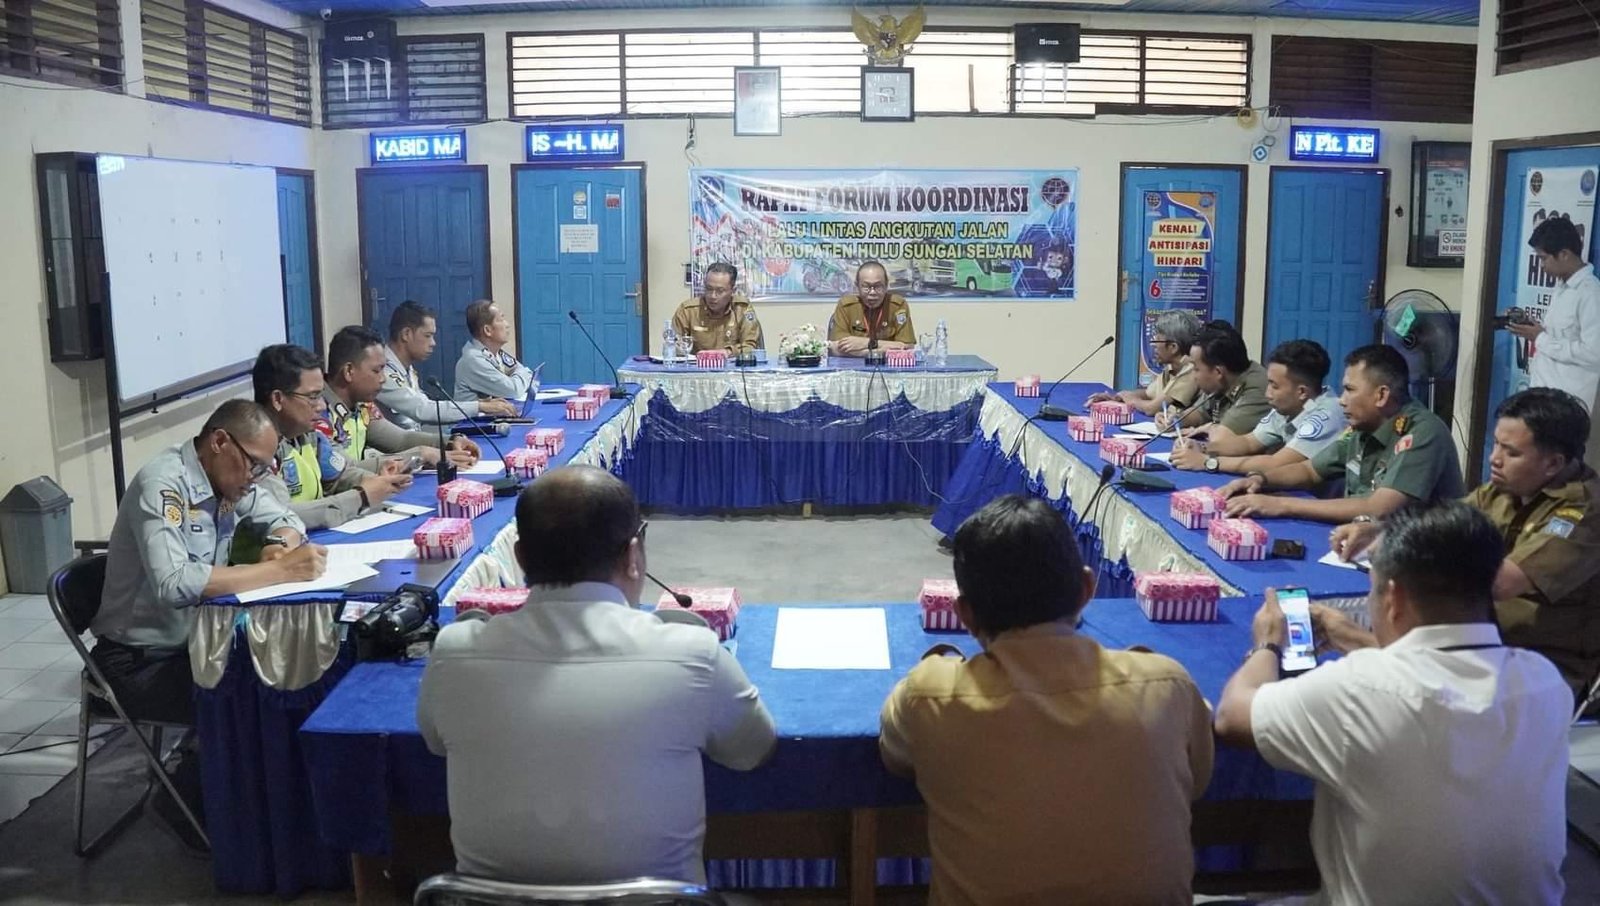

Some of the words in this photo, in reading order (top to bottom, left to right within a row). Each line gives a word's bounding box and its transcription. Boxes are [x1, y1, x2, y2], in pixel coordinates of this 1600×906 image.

[376, 138, 429, 157] KABID
[815, 186, 891, 212] FORUM
[896, 186, 1029, 213] KOORDINASI
[768, 221, 808, 239] LALU
[811, 221, 866, 239] LINTAS
[869, 221, 955, 239] ANGKUTAN
[959, 221, 1008, 239] JALAN
[1158, 225, 1198, 234] KENALI
[742, 242, 758, 259] DI
[761, 243, 853, 260] KABUPATEN
[857, 243, 900, 260] HULU
[903, 243, 963, 260] SUNGAI
[966, 243, 1033, 260] SELATAN
[1149, 241, 1209, 250] ANTISIPASI
[1157, 257, 1203, 266] HINDARI
[1150, 279, 1162, 298] 6
